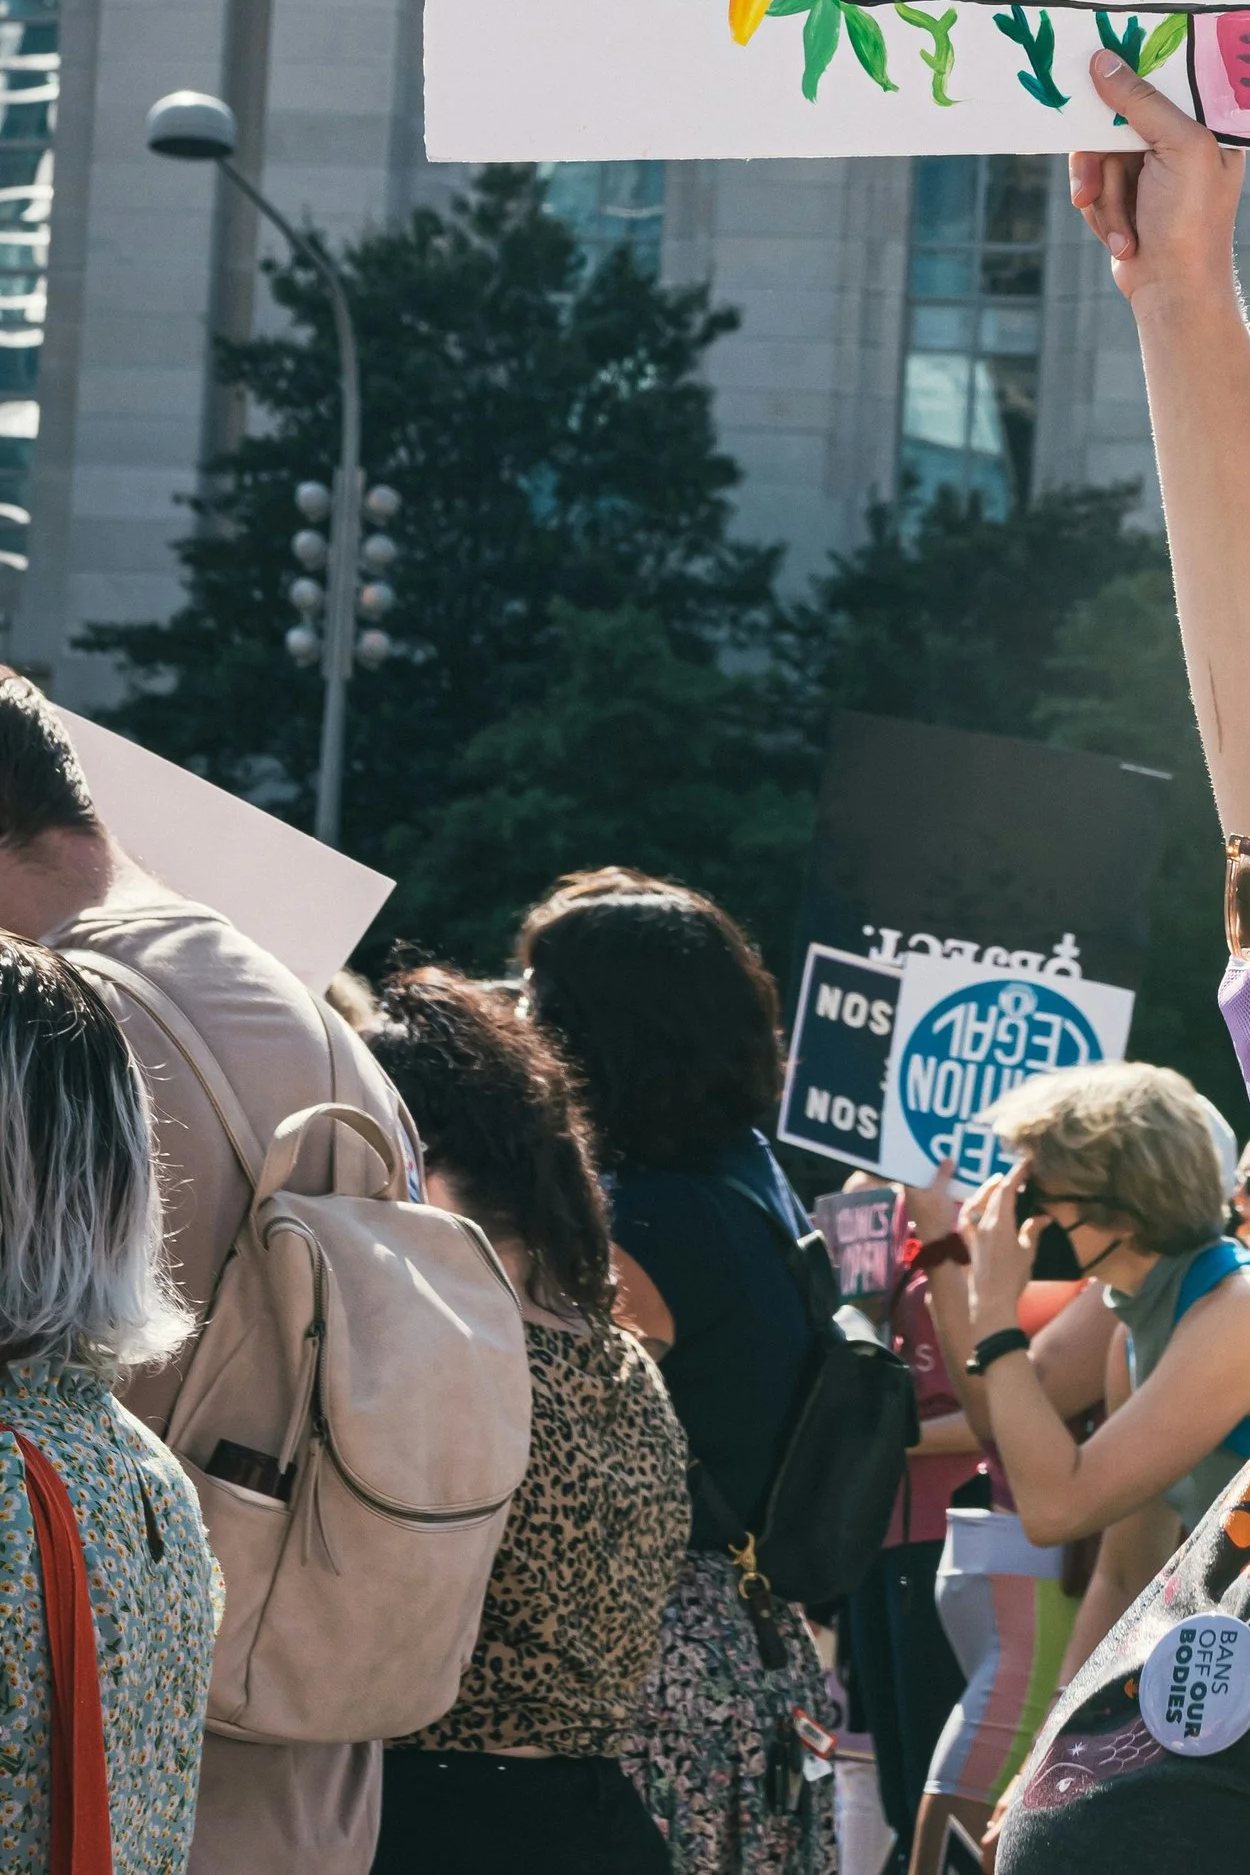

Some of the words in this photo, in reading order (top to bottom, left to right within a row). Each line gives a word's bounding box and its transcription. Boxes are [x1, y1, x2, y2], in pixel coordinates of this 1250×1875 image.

[1165, 1628, 1197, 1725] BODIES
[1195, 1629, 1216, 1677] OFF
[1211, 1630, 1238, 1694] BANS
[1184, 1681, 1207, 1738] OUR
